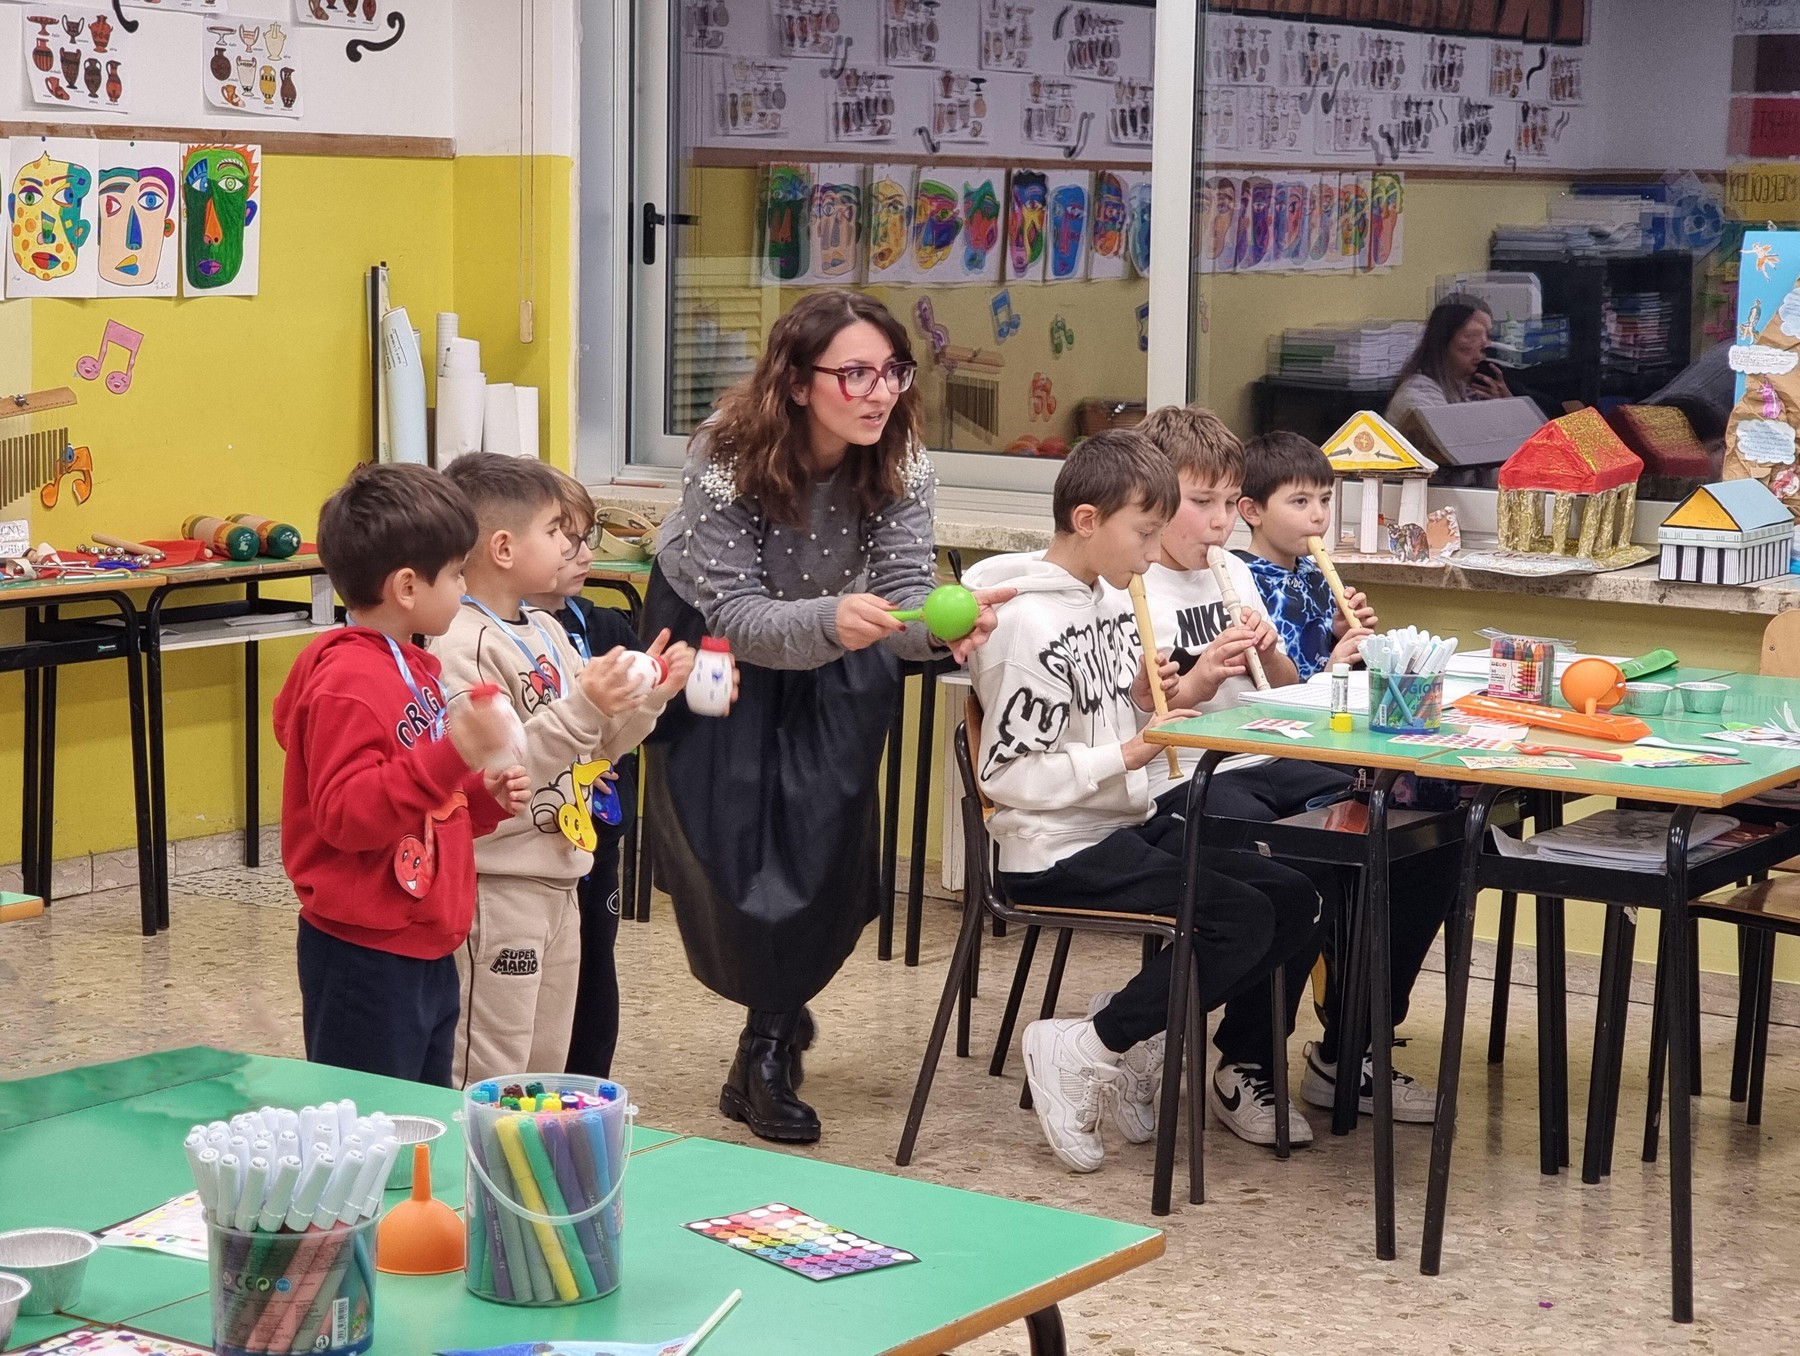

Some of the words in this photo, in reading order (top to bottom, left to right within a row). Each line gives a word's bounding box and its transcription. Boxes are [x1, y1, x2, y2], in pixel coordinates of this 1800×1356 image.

[501, 949, 536, 960] SUPER
[491, 959, 538, 974] MARIO
[236, 1273, 254, 1291] CE
